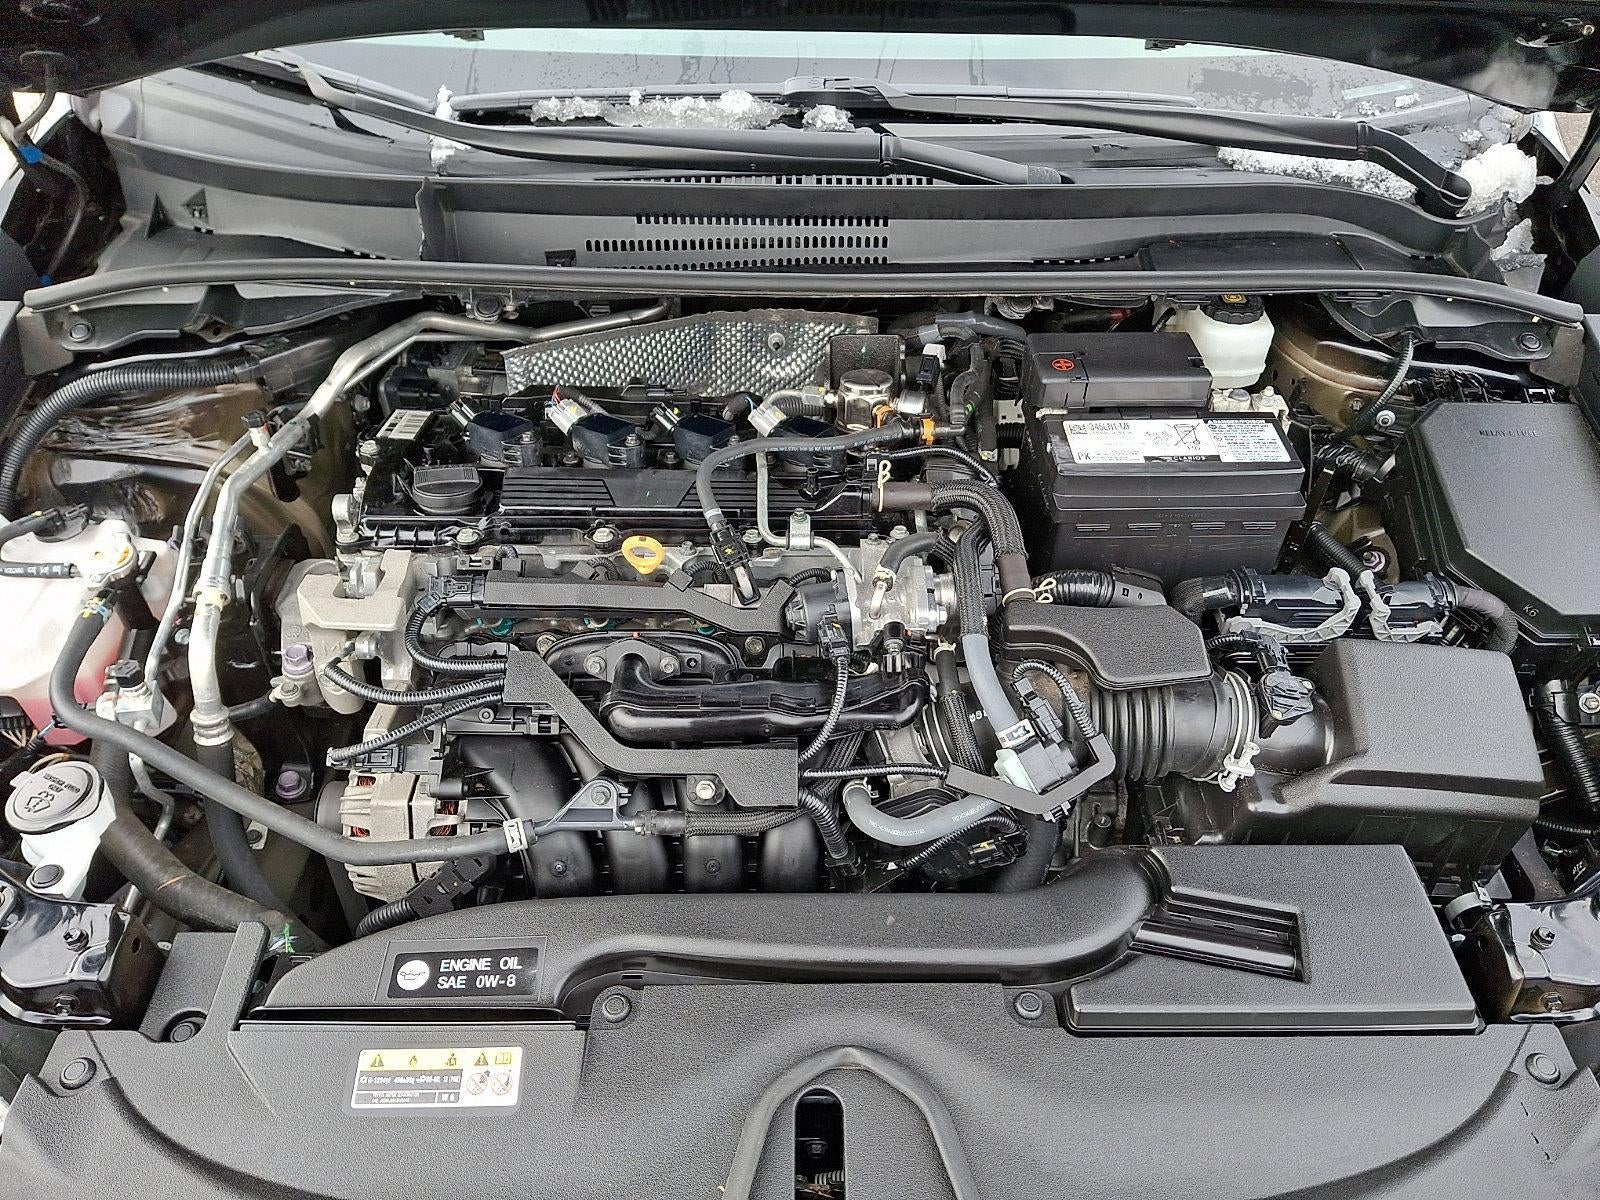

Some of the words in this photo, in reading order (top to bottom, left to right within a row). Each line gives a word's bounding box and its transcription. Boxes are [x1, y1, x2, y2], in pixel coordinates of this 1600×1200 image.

[439, 957, 492, 972] ENGINE
[499, 956, 523, 970] OIL
[436, 975, 467, 989] SAE
[475, 974, 517, 988] 0W-8
